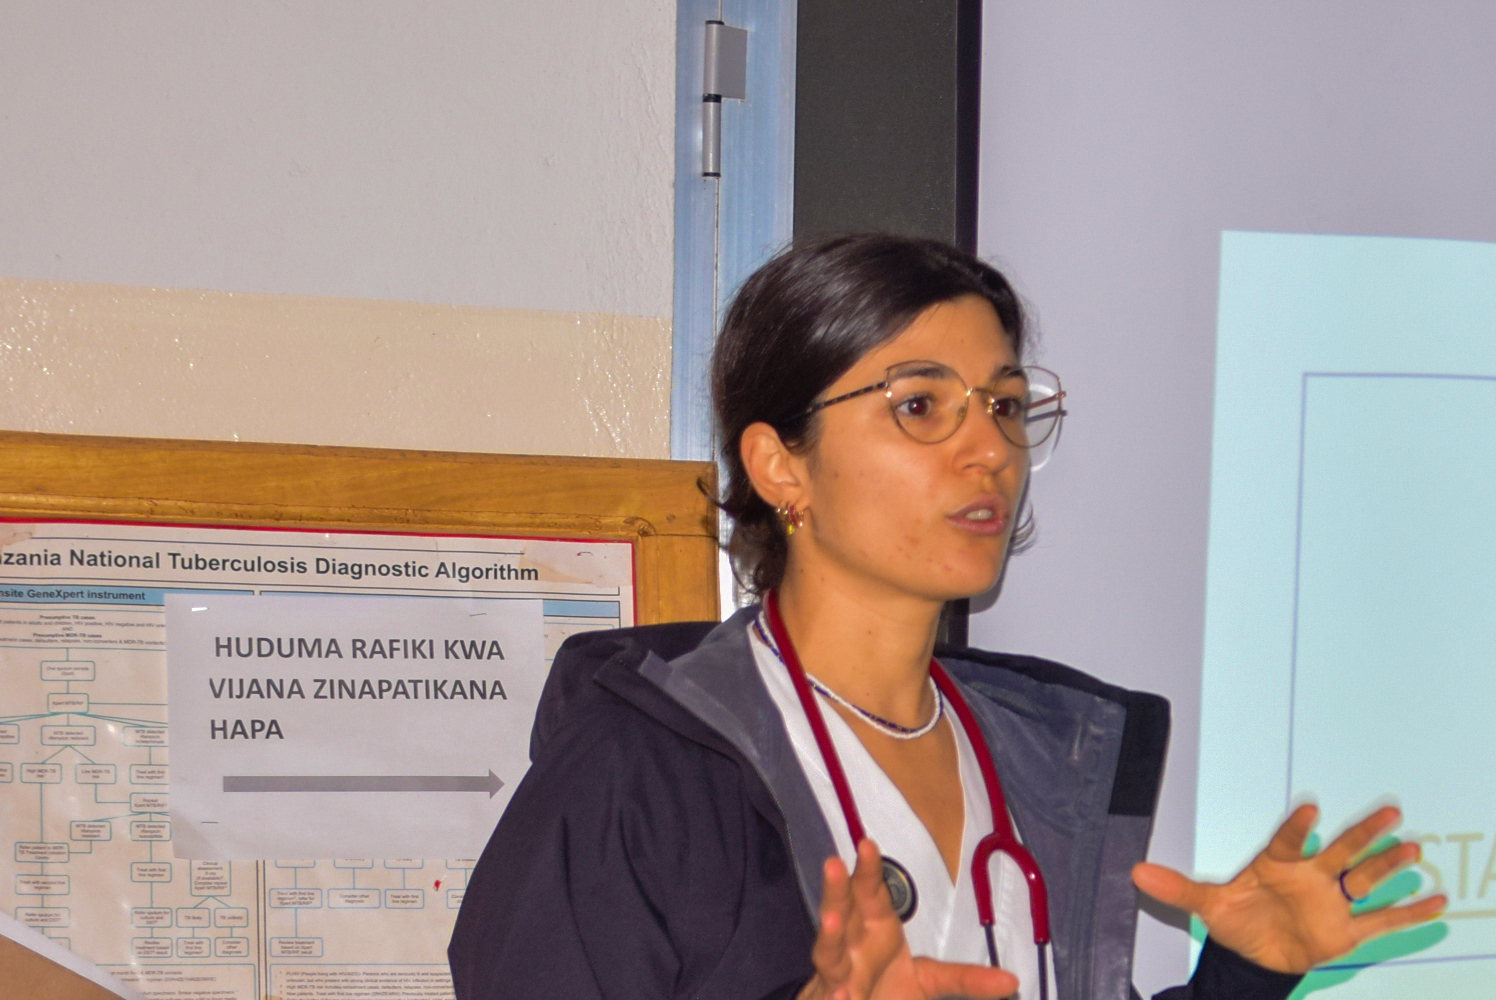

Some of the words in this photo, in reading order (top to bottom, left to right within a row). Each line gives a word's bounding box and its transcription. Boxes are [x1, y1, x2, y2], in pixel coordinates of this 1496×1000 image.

[70, 549, 160, 569] National
[168, 552, 307, 574] Tuberculosis
[315, 558, 429, 580] Diagnostic
[435, 561, 539, 583] Algorithm
[27, 589, 84, 600] GeneXpert
[87, 590, 146, 601] instrument
[215, 636, 343, 659] HUDUMA
[351, 638, 435, 660] RAFIKI
[444, 639, 505, 660] KWA
[209, 678, 305, 699] VIJANA
[313, 678, 507, 700] ZINAPATIKANA
[210, 719, 284, 740] HAPA
